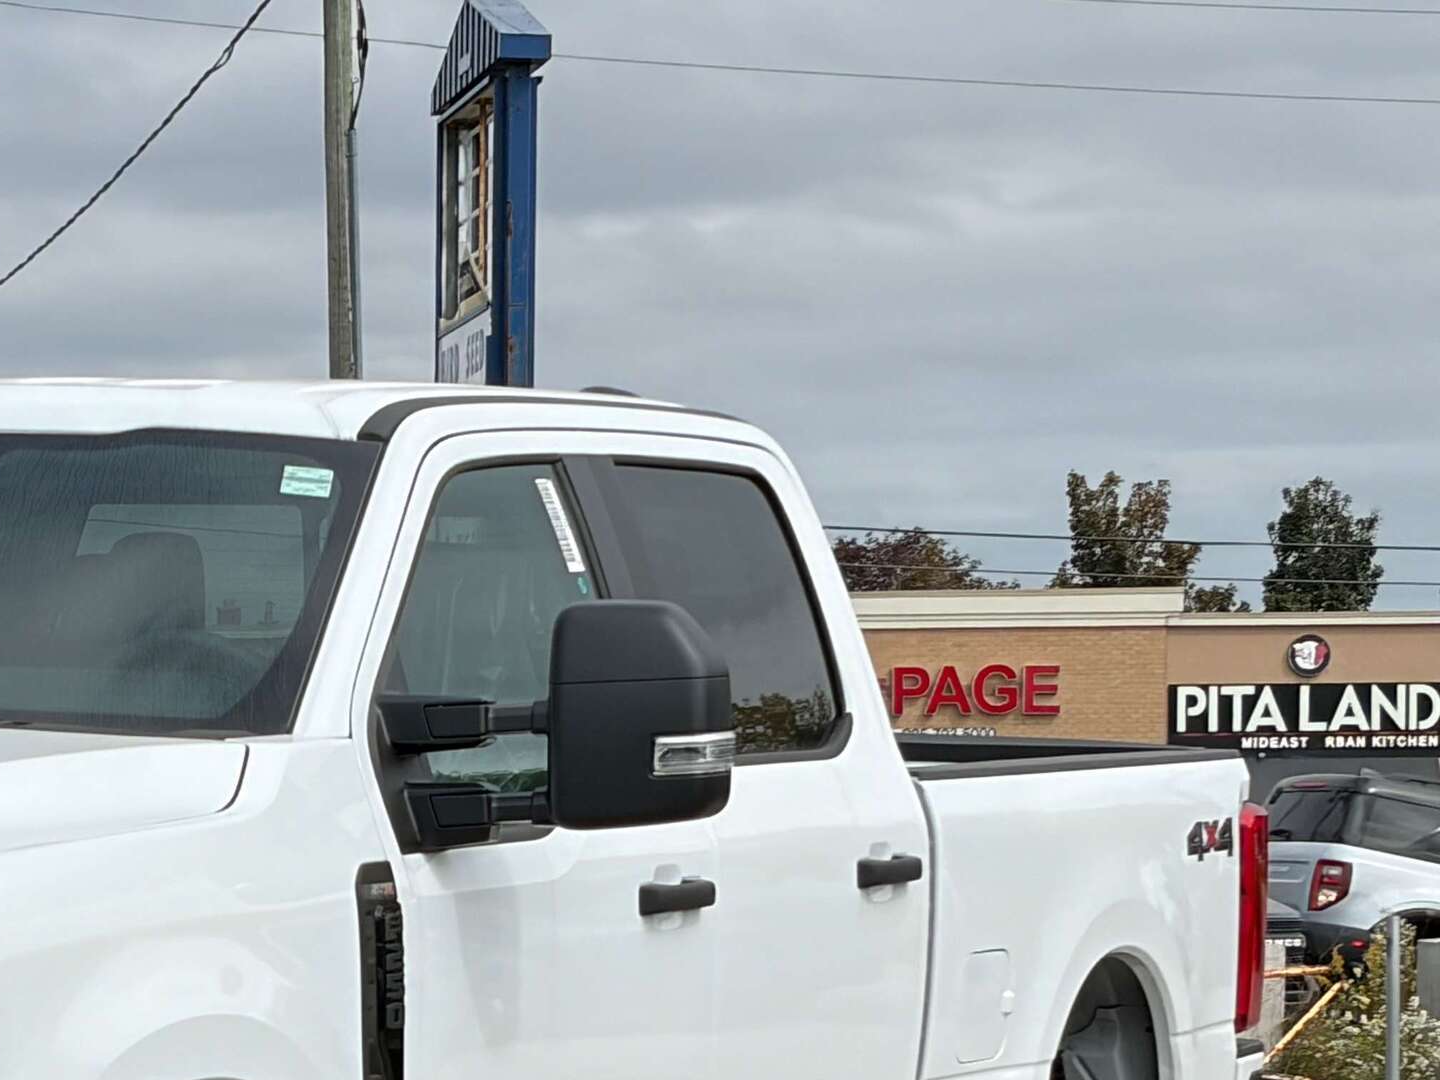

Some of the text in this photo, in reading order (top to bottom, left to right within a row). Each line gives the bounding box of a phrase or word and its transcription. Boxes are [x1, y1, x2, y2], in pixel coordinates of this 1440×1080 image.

[892, 664, 1061, 717] PAGE
[1176, 684, 1440, 733] PITA LAND
[1241, 737, 1310, 749] MIDEAST
[1372, 735, 1439, 748] KITCHEN
